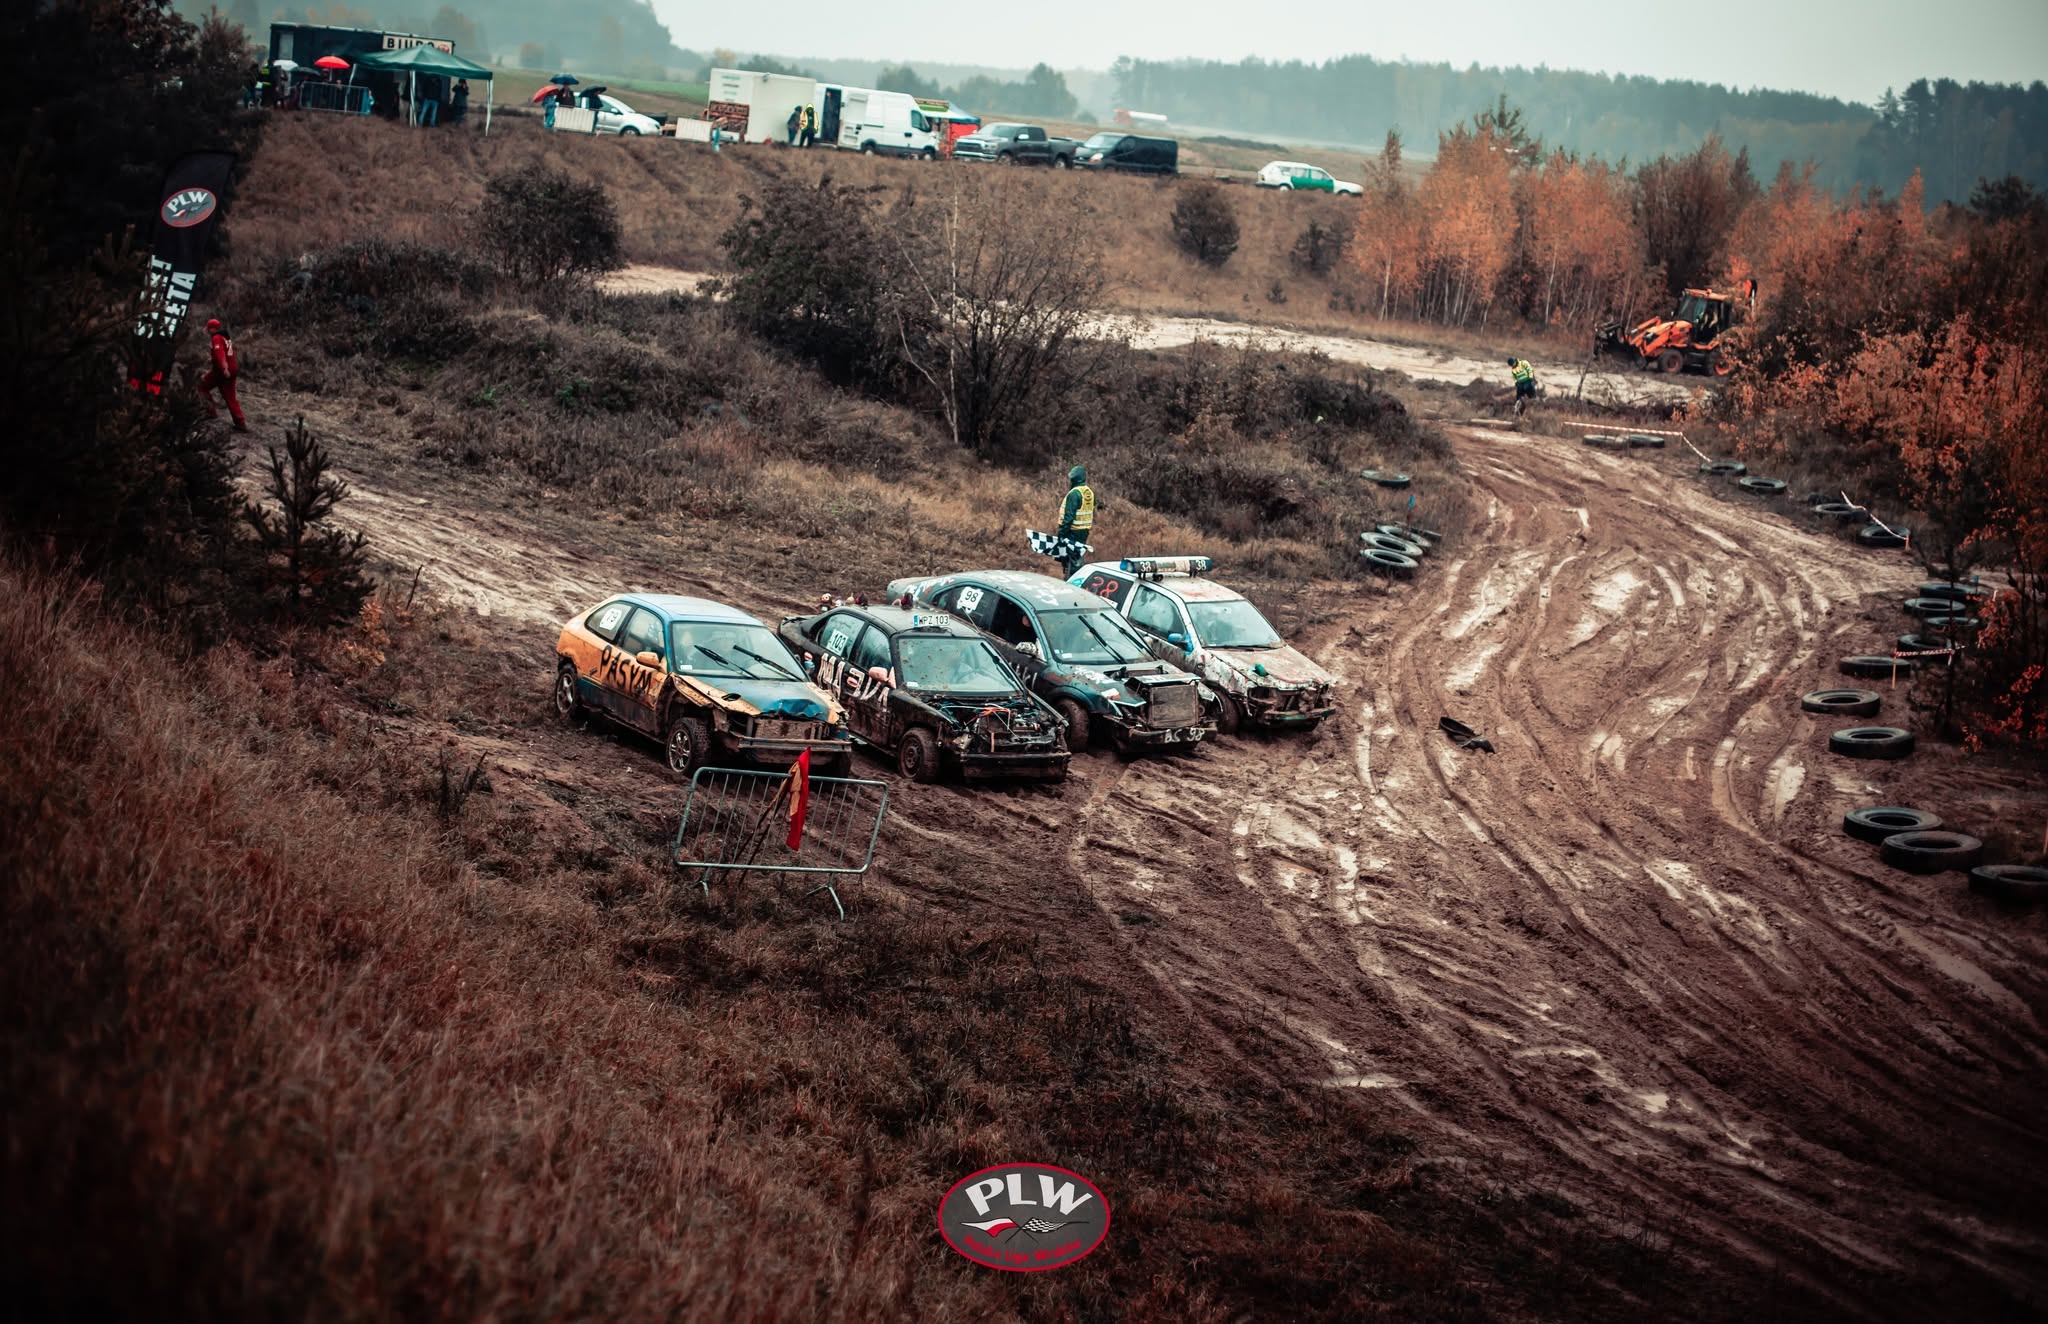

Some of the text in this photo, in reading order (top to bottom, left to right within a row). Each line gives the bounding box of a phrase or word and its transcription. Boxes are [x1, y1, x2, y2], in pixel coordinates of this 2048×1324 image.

[166, 191, 209, 213] PLW
[964, 590, 979, 603] 98
[935, 615, 950, 625] 103
[832, 632, 848, 652] 103
[599, 644, 653, 696] PASYM
